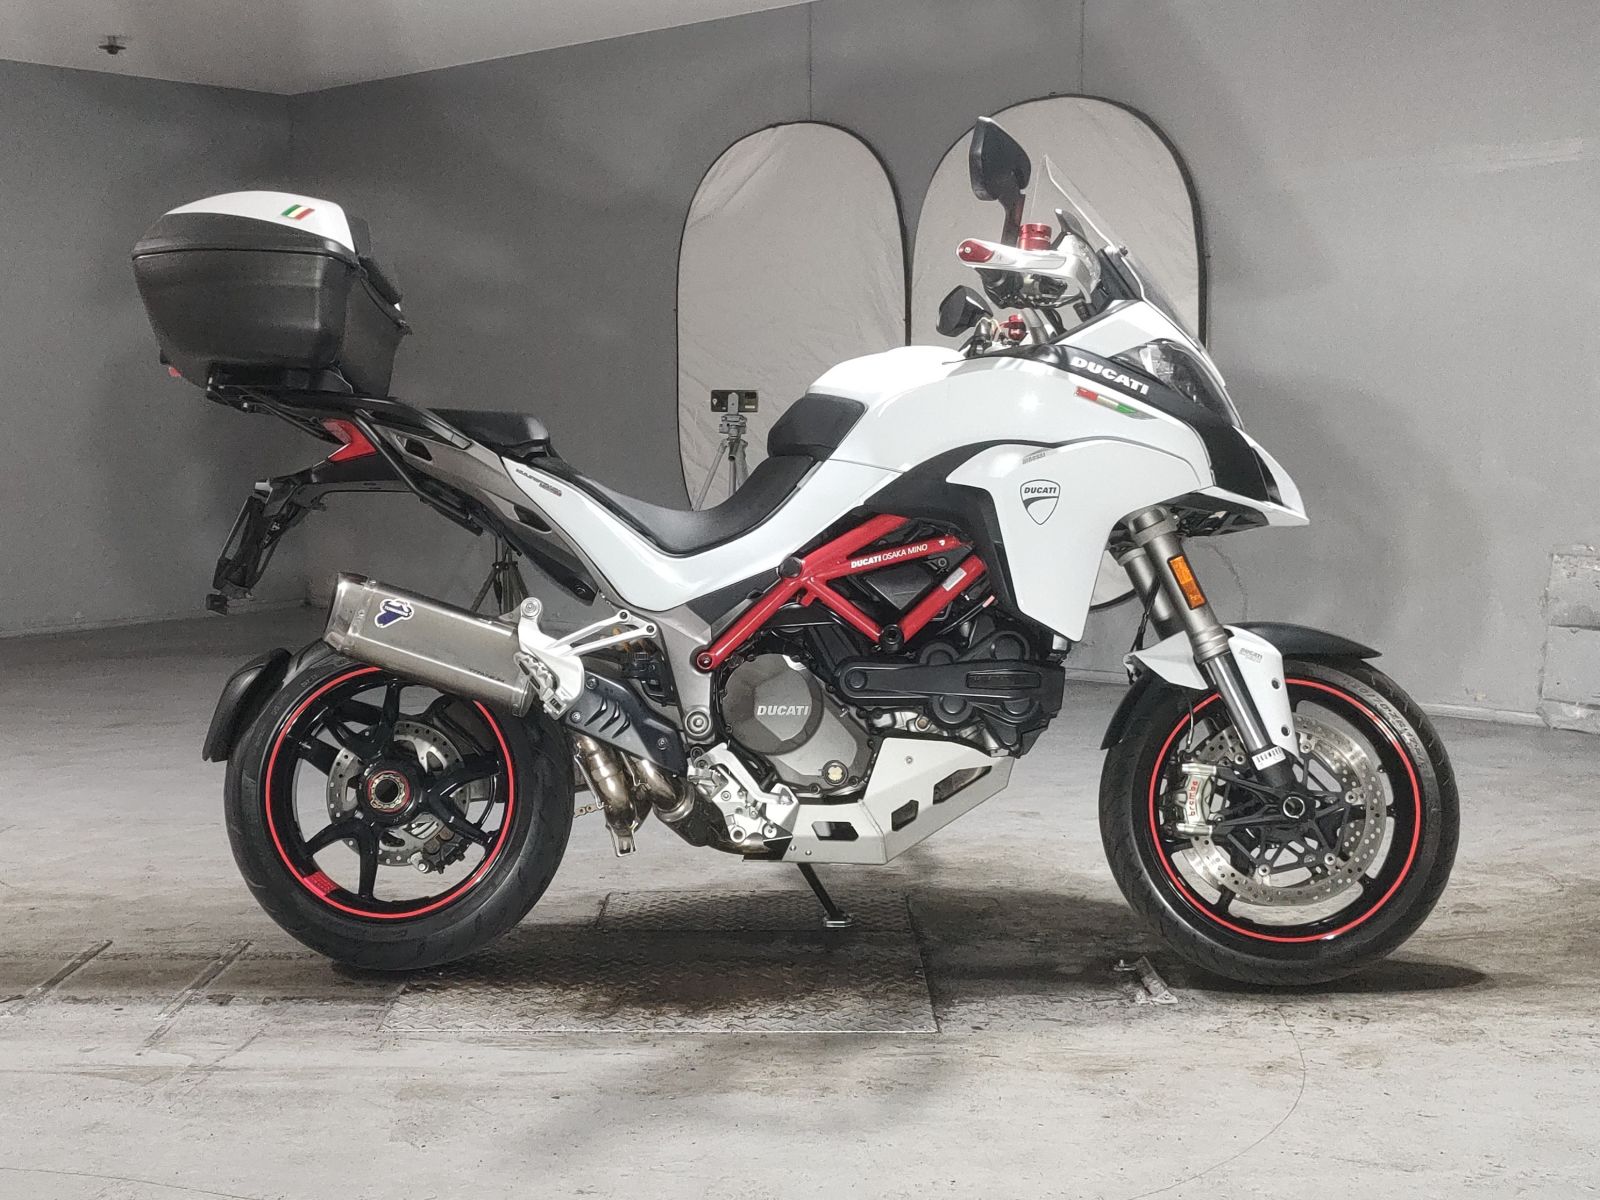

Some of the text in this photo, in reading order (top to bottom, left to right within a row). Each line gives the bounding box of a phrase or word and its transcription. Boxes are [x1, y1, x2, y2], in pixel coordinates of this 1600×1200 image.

[1070, 356, 1149, 395] DUCATI
[850, 543, 928, 569] DUCATI OSAKA MINO
[757, 705, 809, 716] DUCATI
[1188, 780, 1199, 817] brembo
